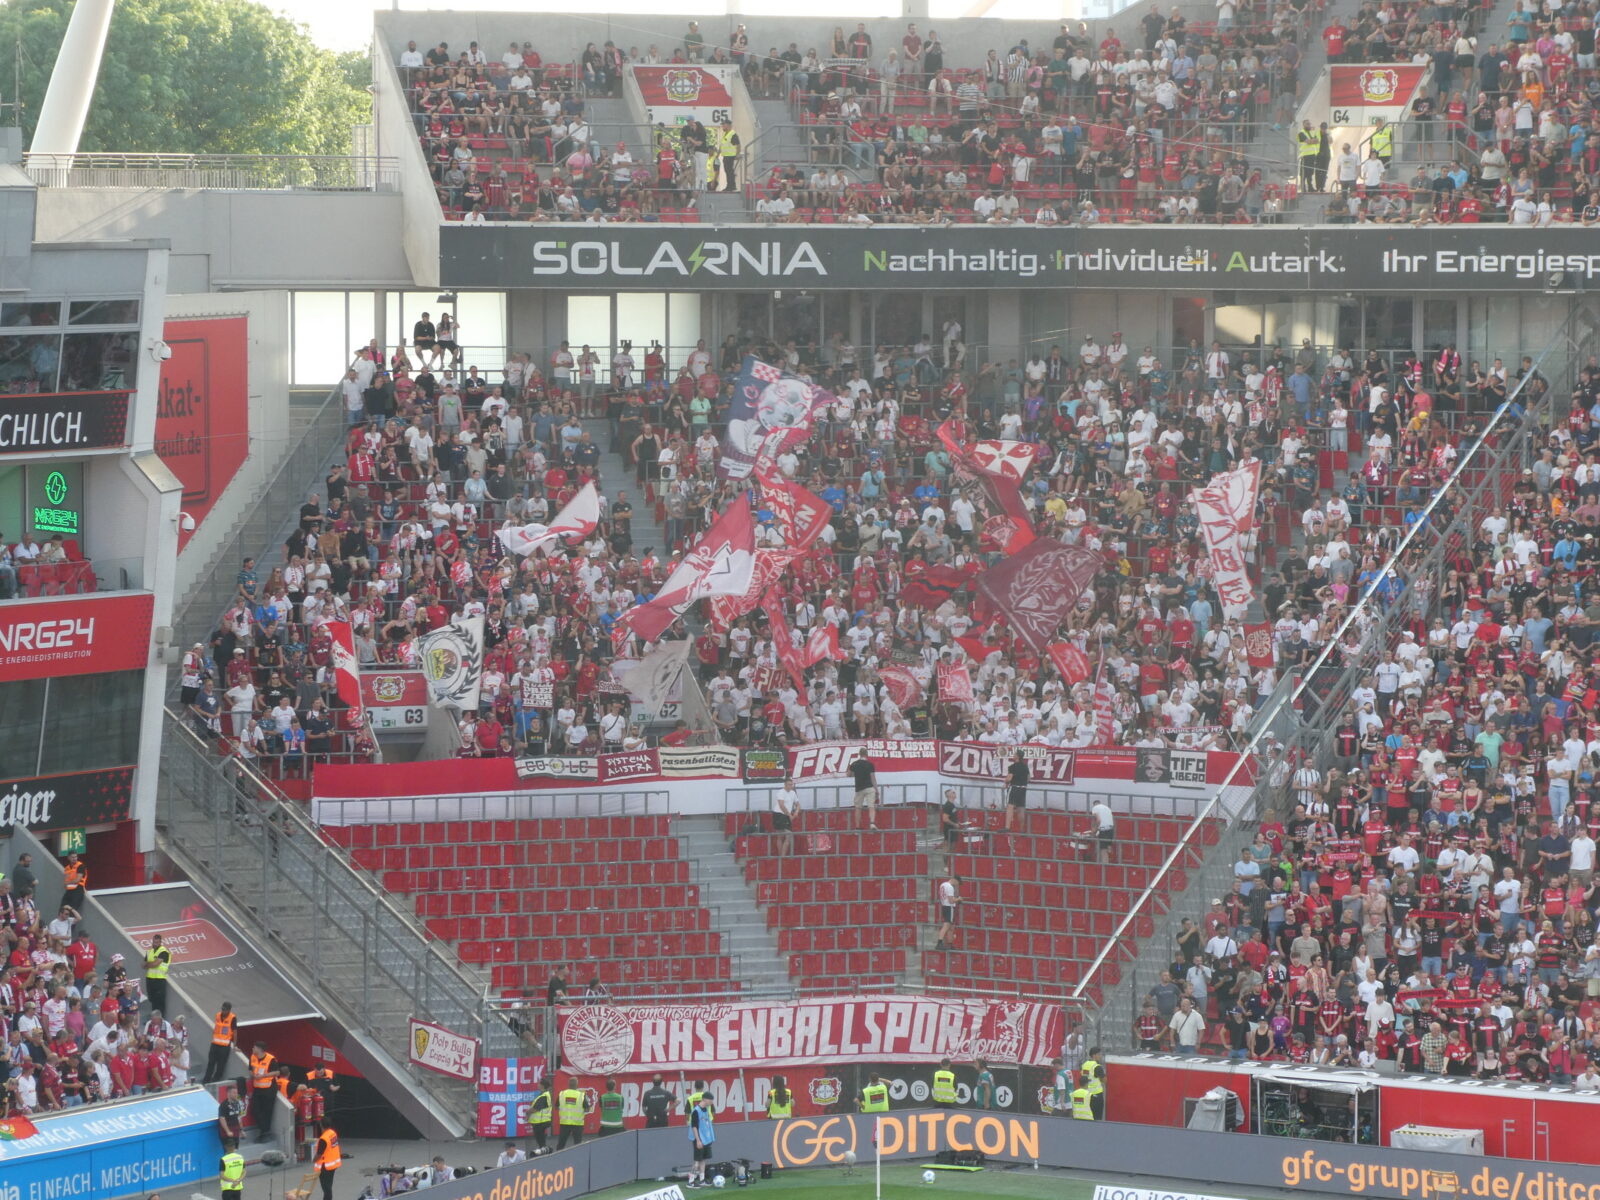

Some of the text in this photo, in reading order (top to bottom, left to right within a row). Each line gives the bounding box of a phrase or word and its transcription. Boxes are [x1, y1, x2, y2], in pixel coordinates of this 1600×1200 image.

[712, 109, 729, 123] G5
[1333, 109, 1350, 123] G4
[532, 240, 828, 277] SOLARNIA
[863, 249, 1347, 278] Nachhaltig. Individuell. Autark.
[1382, 249, 1427, 273] Ihr
[405, 708, 424, 724] G3
[1170, 757, 1207, 772] TIFO
[641, 1002, 991, 1063] RASENBALLSPORT
[480, 1065, 544, 1085] BLOCK
[621, 1076, 788, 1118] BE04.D
[11, 1104, 199, 1151] EINFACH. MENSCHLICH.
[880, 1112, 1039, 1159] DITCON
[29, 1171, 96, 1200] EINFACH.
[101, 1152, 197, 1190] MENSCHLICH.
